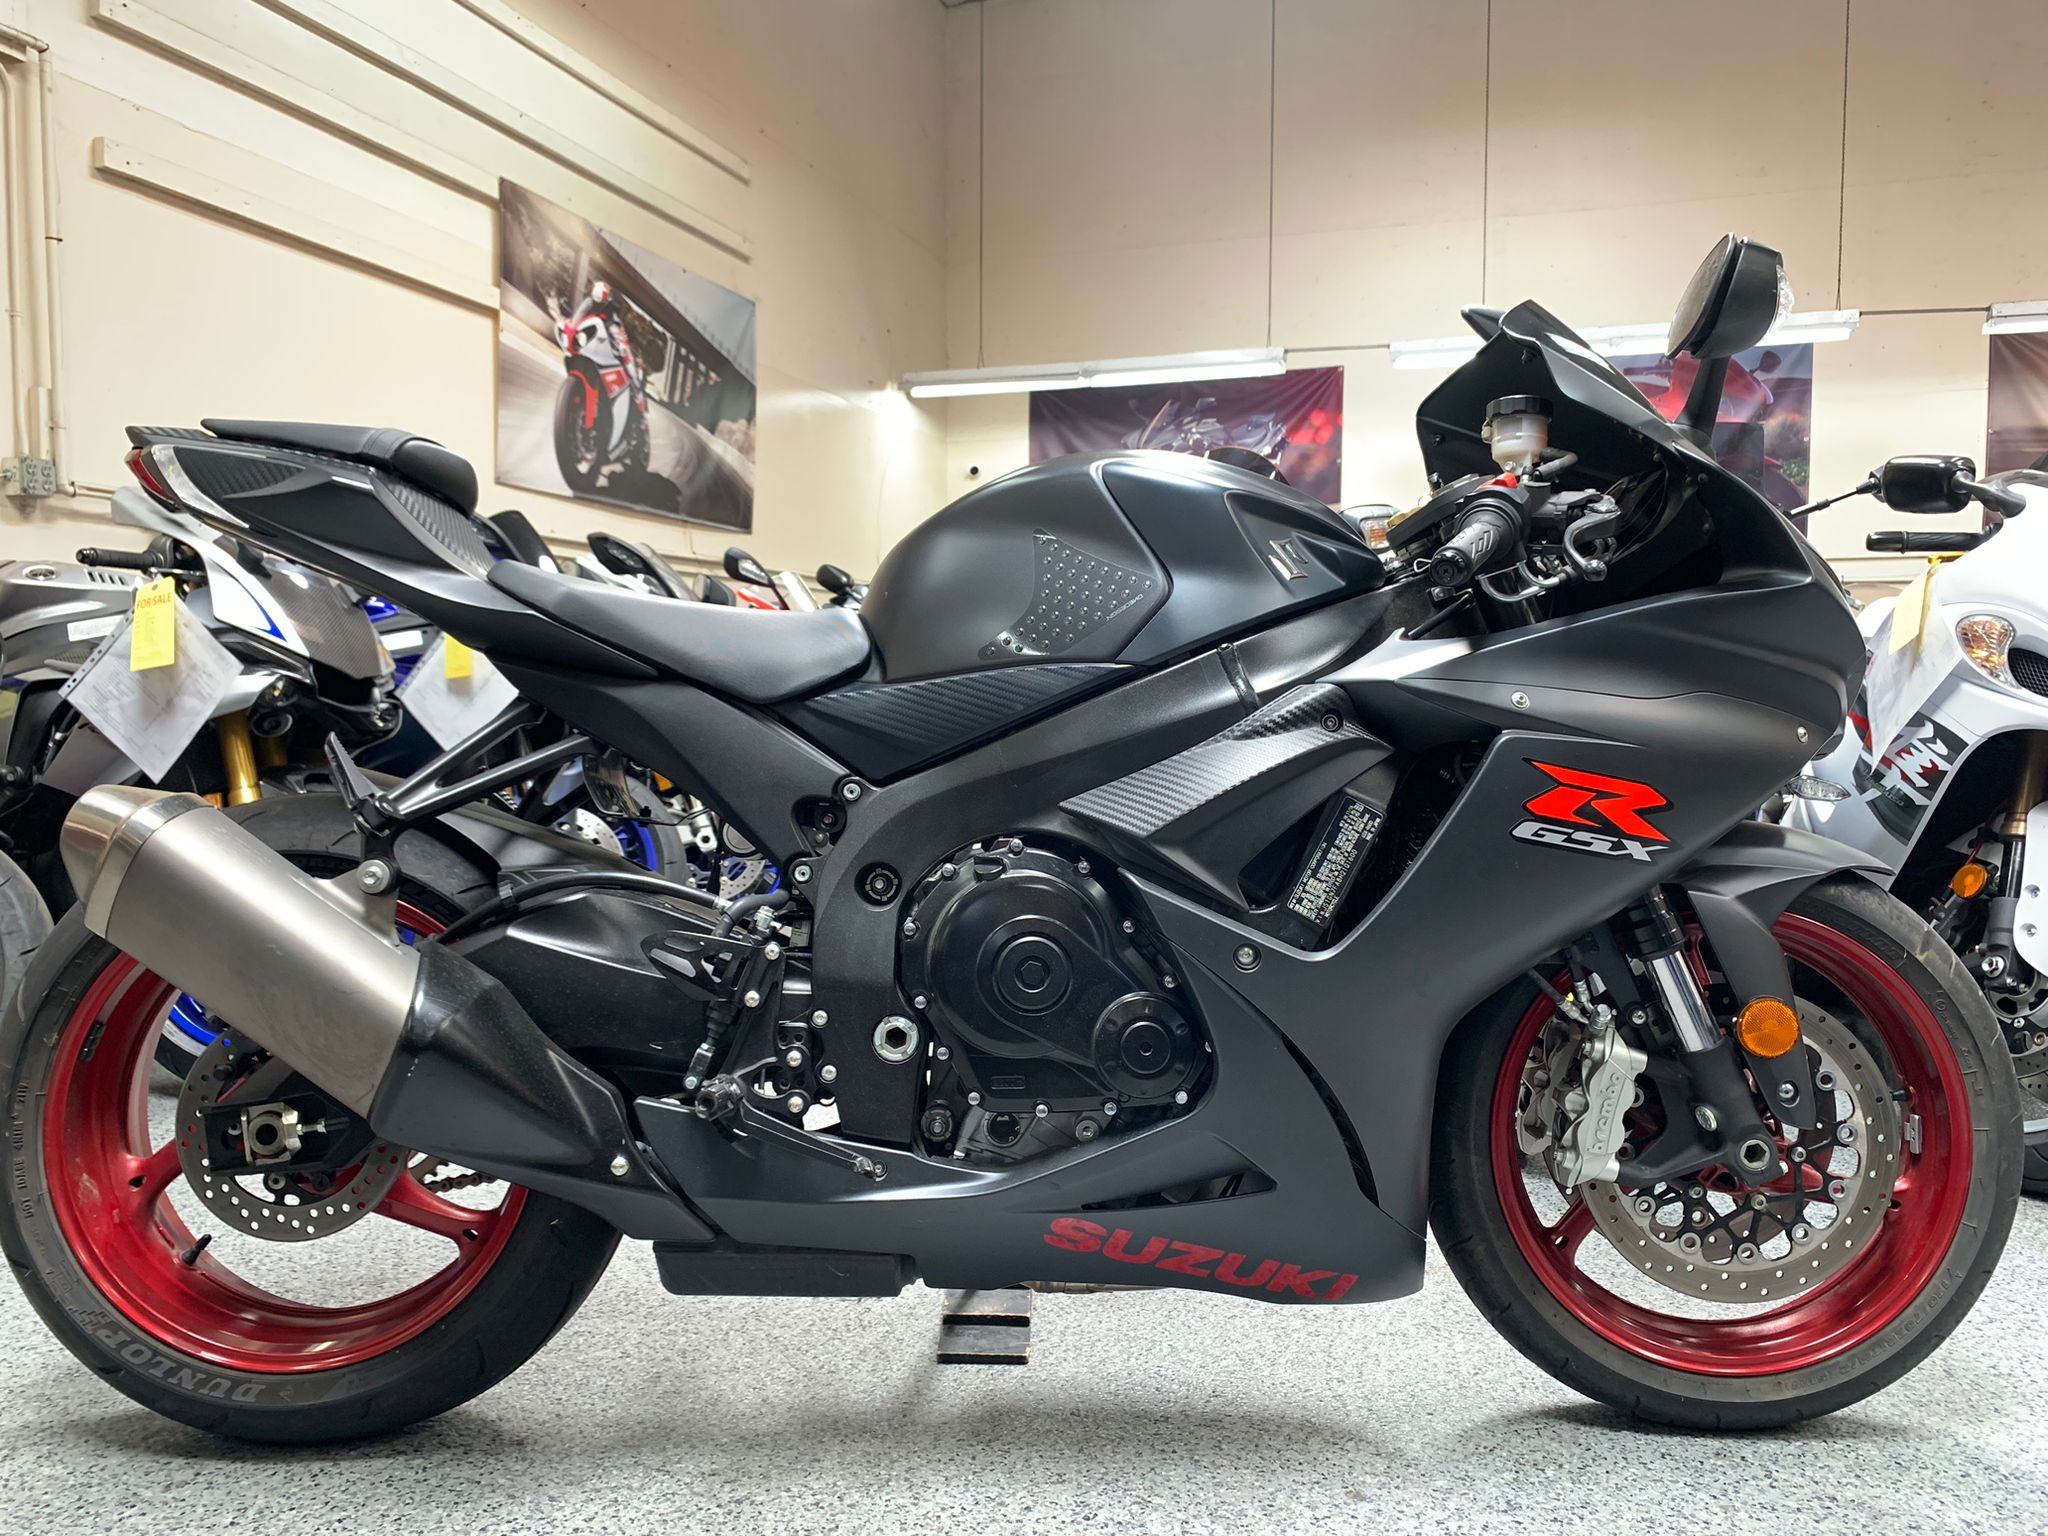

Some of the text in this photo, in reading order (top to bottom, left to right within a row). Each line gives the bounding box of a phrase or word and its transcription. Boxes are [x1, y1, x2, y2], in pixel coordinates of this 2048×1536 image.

[137, 593, 172, 608] FOR SALE
[1512, 820, 1669, 862] GSX
[1587, 1073, 1620, 1154] brembo
[1043, 1217, 1359, 1300] SUZUKI
[97, 1324, 264, 1403] DUNLOP
